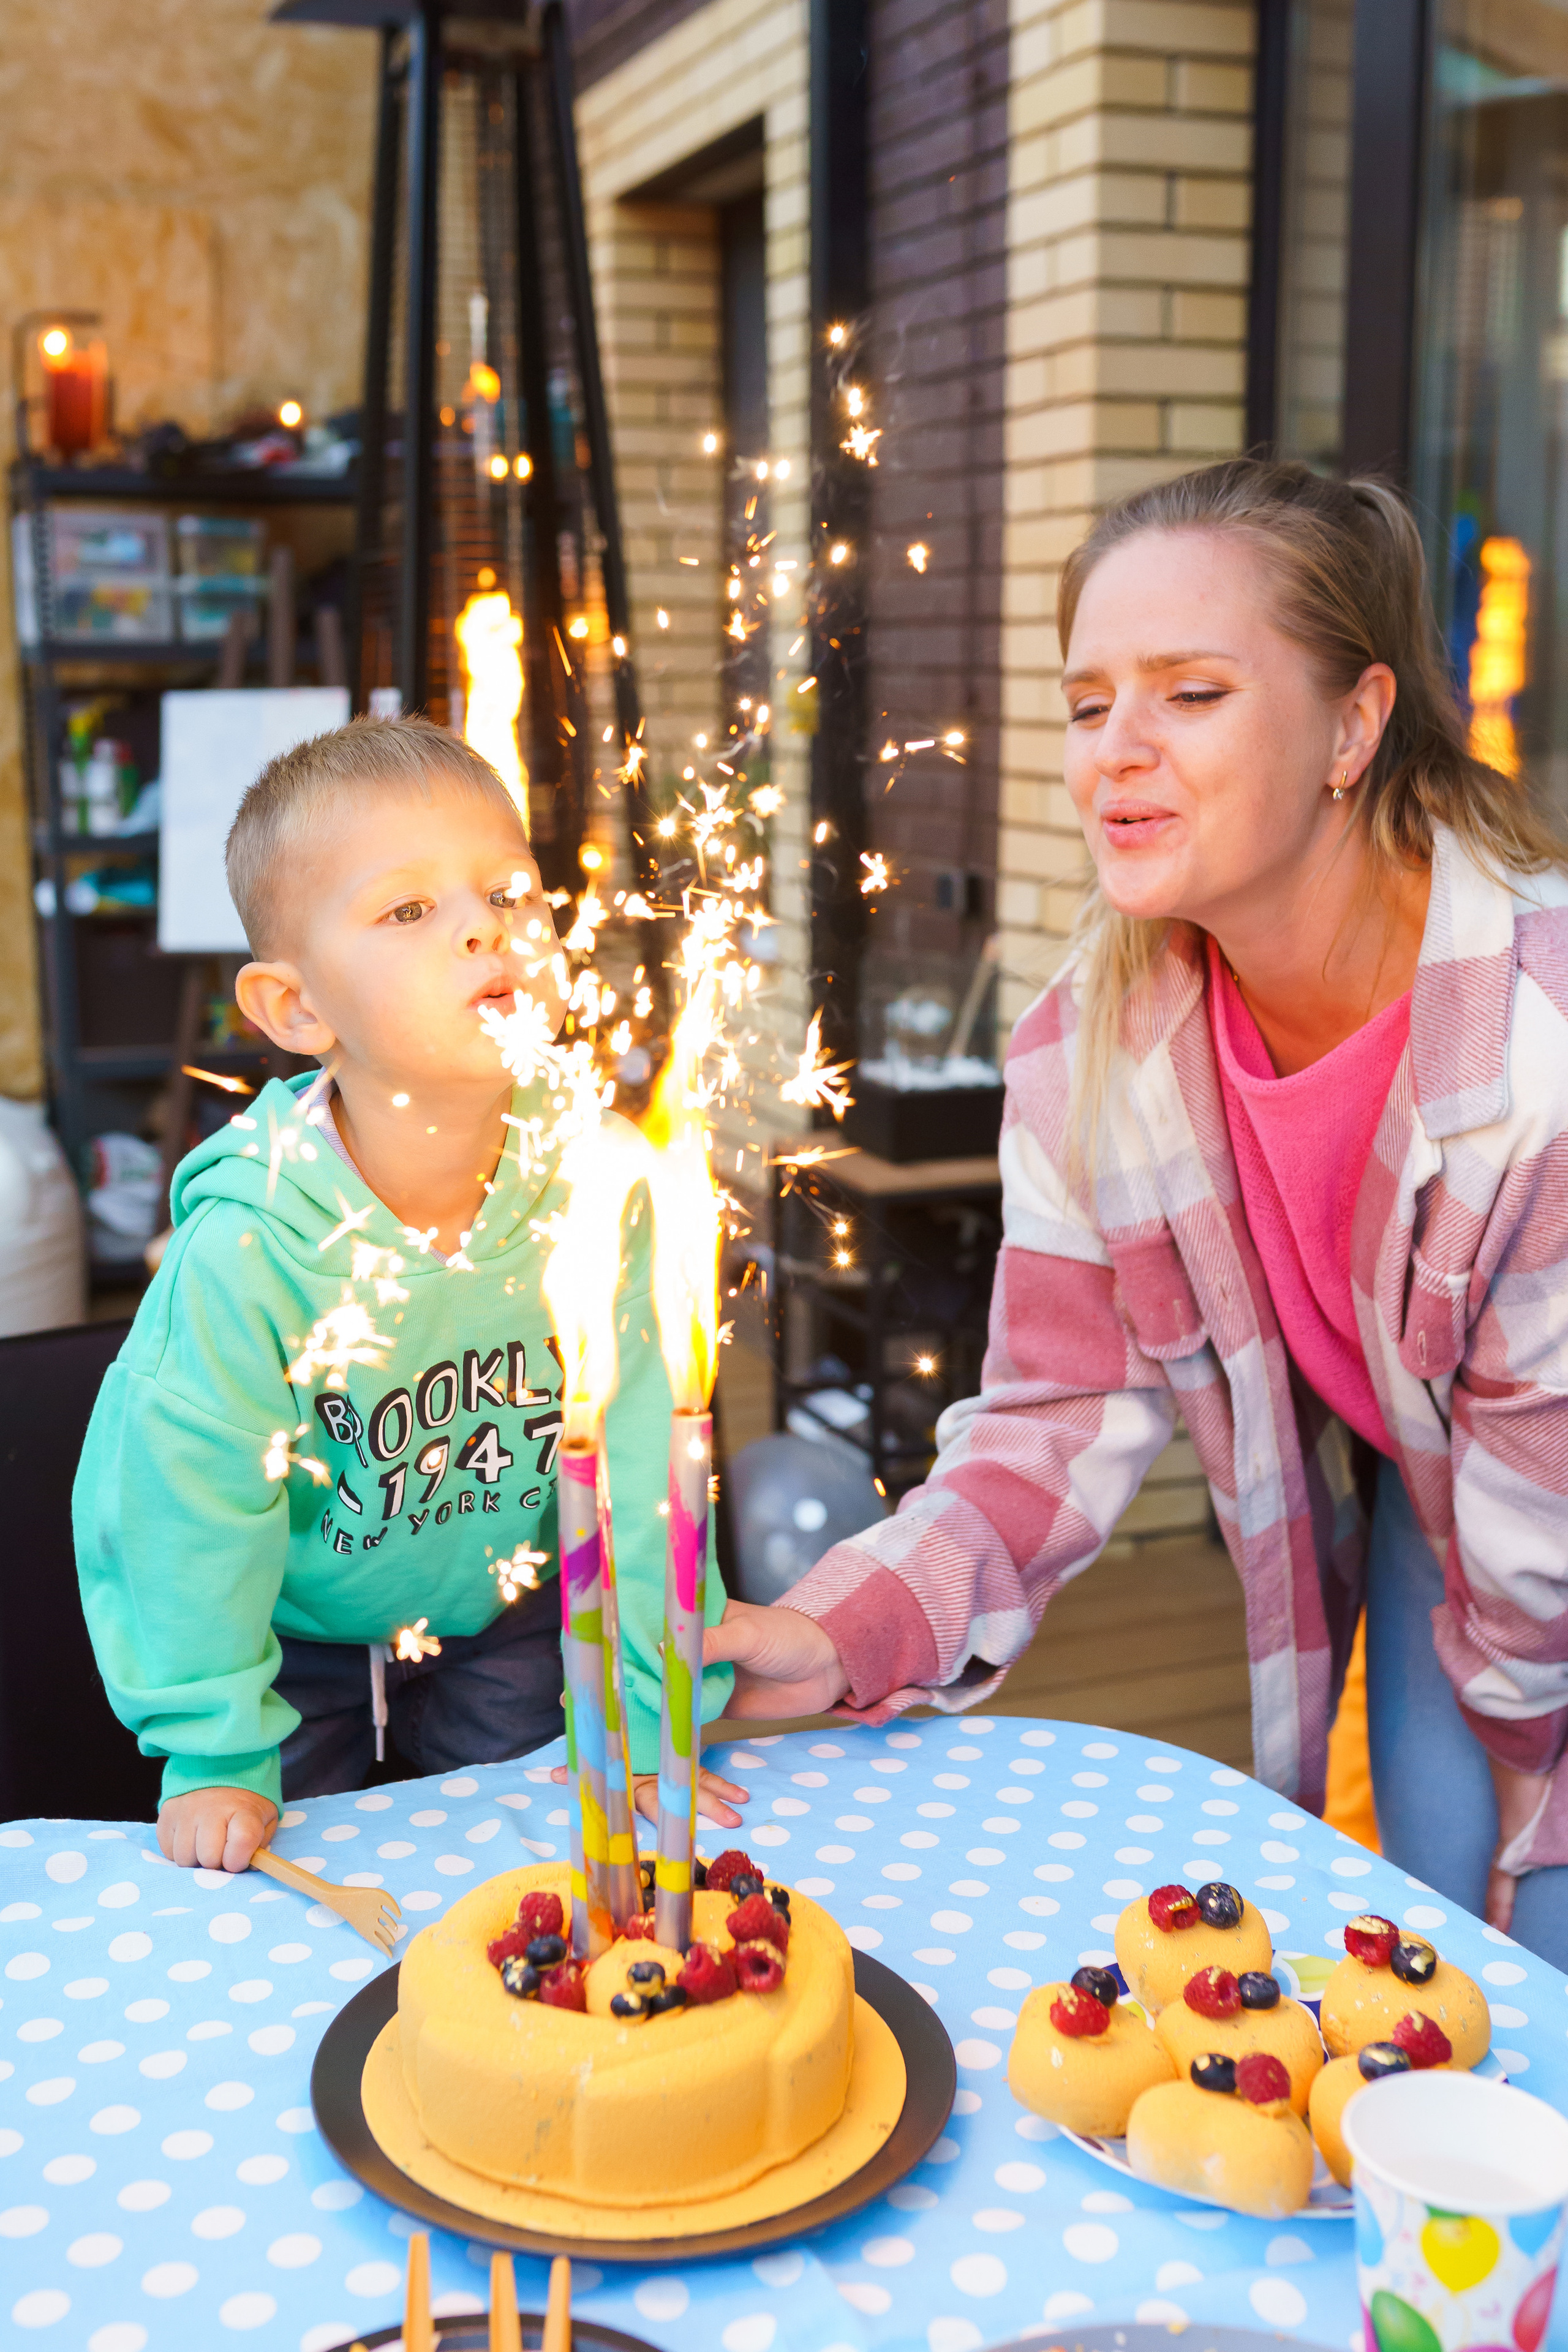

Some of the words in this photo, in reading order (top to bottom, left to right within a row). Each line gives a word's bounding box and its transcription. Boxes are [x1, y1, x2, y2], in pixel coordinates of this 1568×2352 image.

[378, 1411, 565, 1521] 1947
[320, 1508, 388, 1555] NEW
[407, 1490, 501, 1536] YORK
